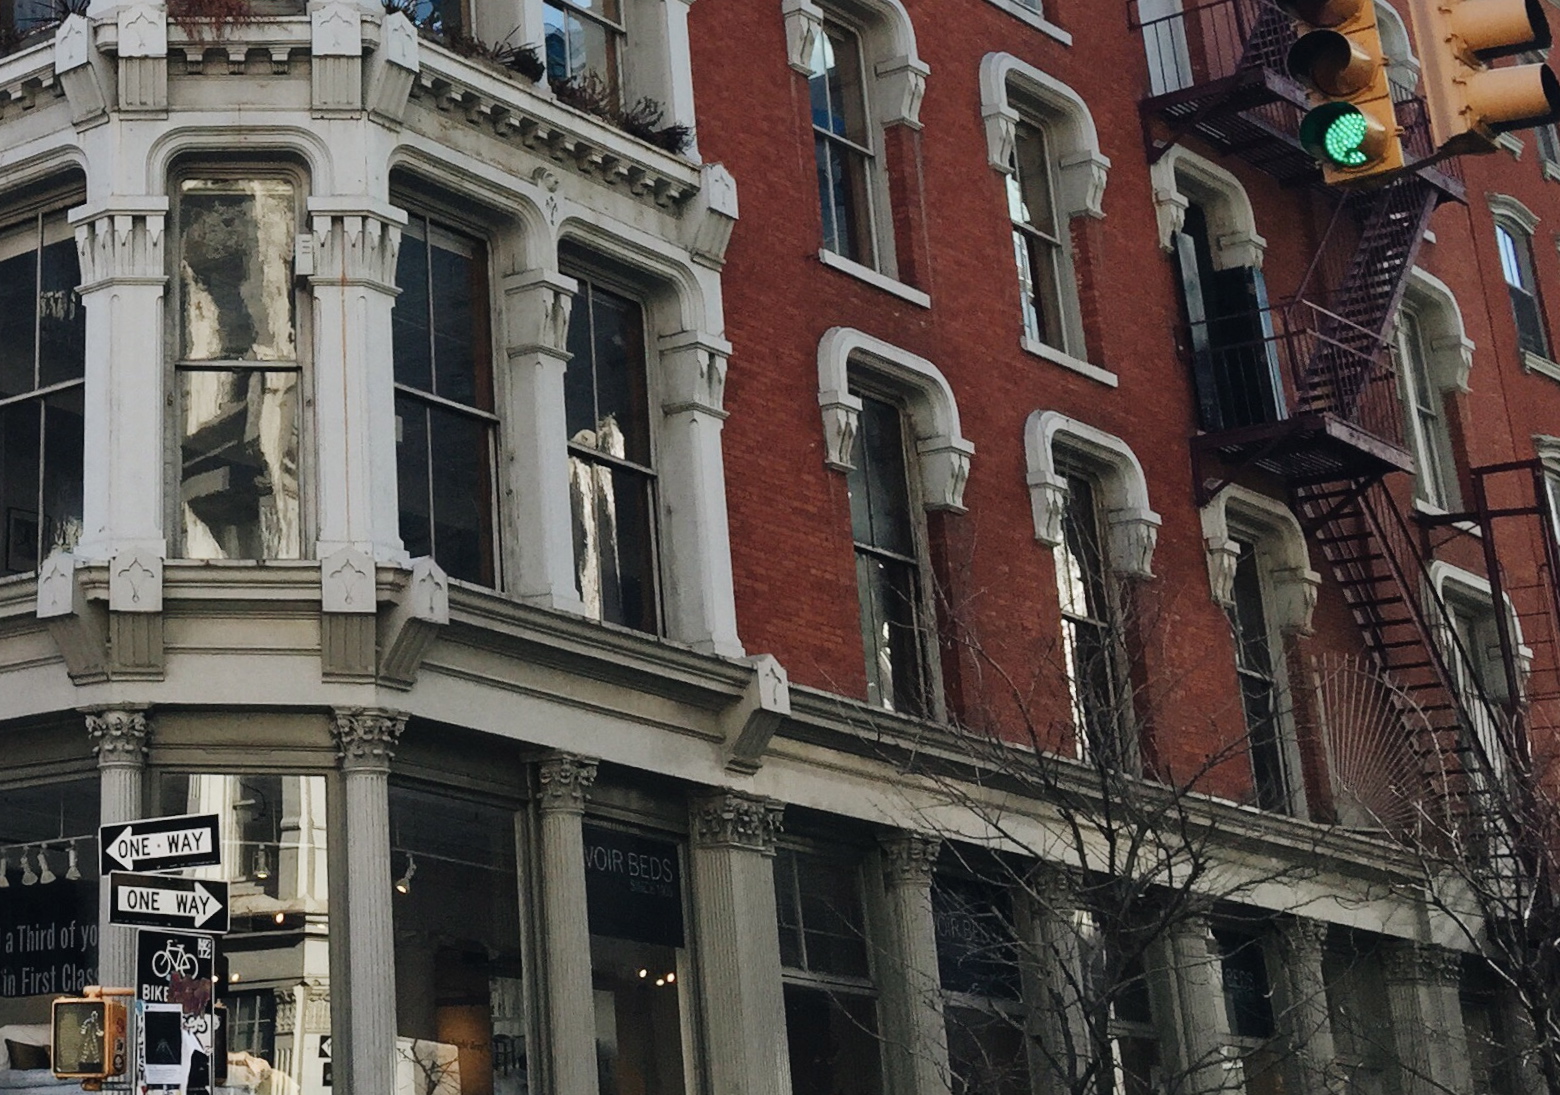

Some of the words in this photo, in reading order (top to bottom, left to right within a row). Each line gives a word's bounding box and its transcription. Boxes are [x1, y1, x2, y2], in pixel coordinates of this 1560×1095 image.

[118, 837, 151, 859] ONE
[167, 831, 203, 853] WAY
[627, 852, 673, 883] BEDS
[127, 889, 160, 911] ONE
[175, 894, 210, 915] WAY
[5, 931, 14, 953] a
[17, 922, 55, 952] Third
[60, 920, 76, 949] of
[2, 969, 16, 996] in
[21, 965, 56, 995] First
[142, 984, 170, 1003] BIKE
